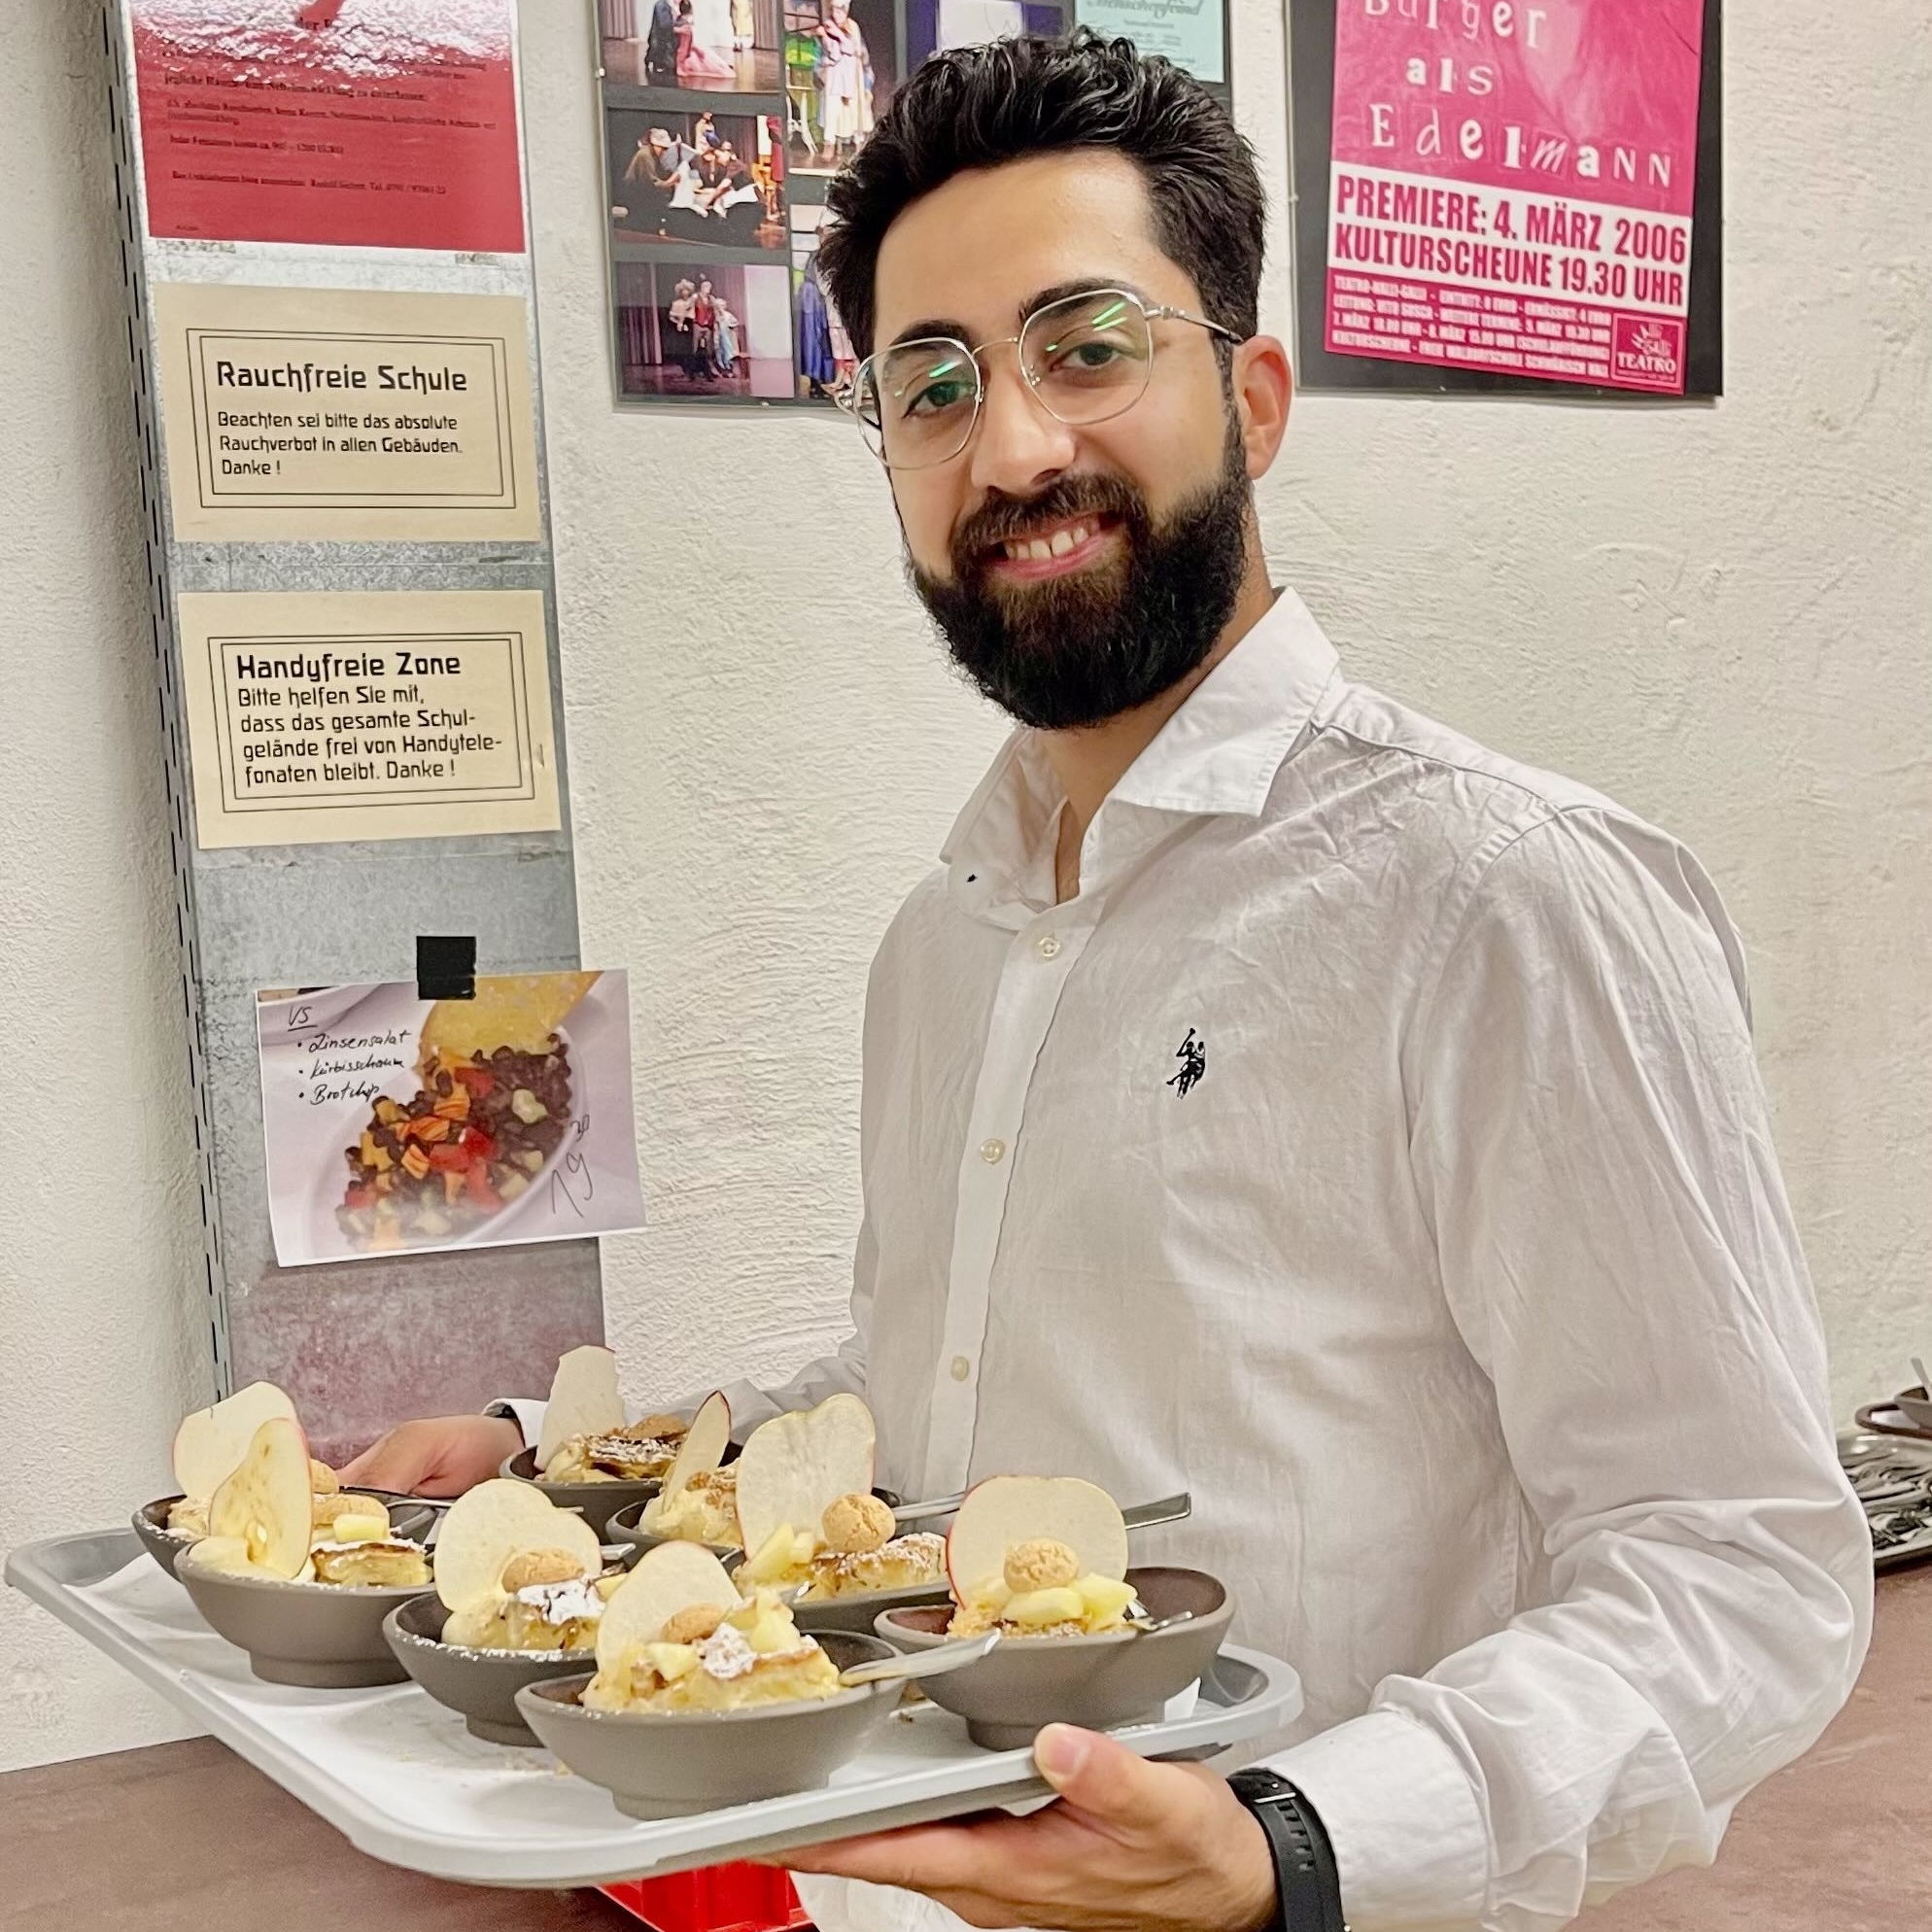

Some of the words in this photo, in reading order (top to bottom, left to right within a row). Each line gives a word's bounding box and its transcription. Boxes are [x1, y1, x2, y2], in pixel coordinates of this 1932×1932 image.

[1406, 57, 1494, 96] als
[1336, 175, 1488, 236] PREMIERE:
[1494, 200, 1517, 240] 4.
[1527, 201, 1602, 252] MÄRZ
[1614, 219, 1686, 264] 2006
[1334, 223, 1552, 288] KULTURSCHEUNE
[1559, 256, 1627, 298] 19.30
[1634, 267, 1682, 307] UHR
[1617, 352, 1676, 374] TEATRO
[217, 361, 366, 393] Rauchfreie
[377, 365, 466, 395] Schule
[218, 411, 293, 430] Beachten
[297, 413, 320, 428] sei
[325, 413, 359, 429] bitte
[363, 414, 390, 429] das
[395, 415, 458, 430] absolute
[220, 435, 317, 453] Rauchverbot
[323, 437, 335, 452] in
[340, 437, 377, 452] allen
[382, 437, 463, 453] Gebäuden.
[222, 460, 271, 475] Danke
[237, 653, 385, 682] Handyfreie
[396, 652, 461, 675] Zone
[238, 688, 281, 707] Bitte
[288, 687, 350, 708] helfen
[356, 685, 386, 704] Sie
[241, 715, 285, 732] dass
[292, 713, 325, 730] das
[331, 710, 411, 733] gesamte
[417, 708, 476, 729] Schul-
[243, 740, 319, 762] gelände
[326, 736, 358, 759] frei
[363, 739, 397, 754] von
[402, 734, 502, 755] Handytele-
[245, 766, 317, 788] fonaten
[324, 761, 380, 781] bleibt.
[387, 759, 444, 778] Danke
